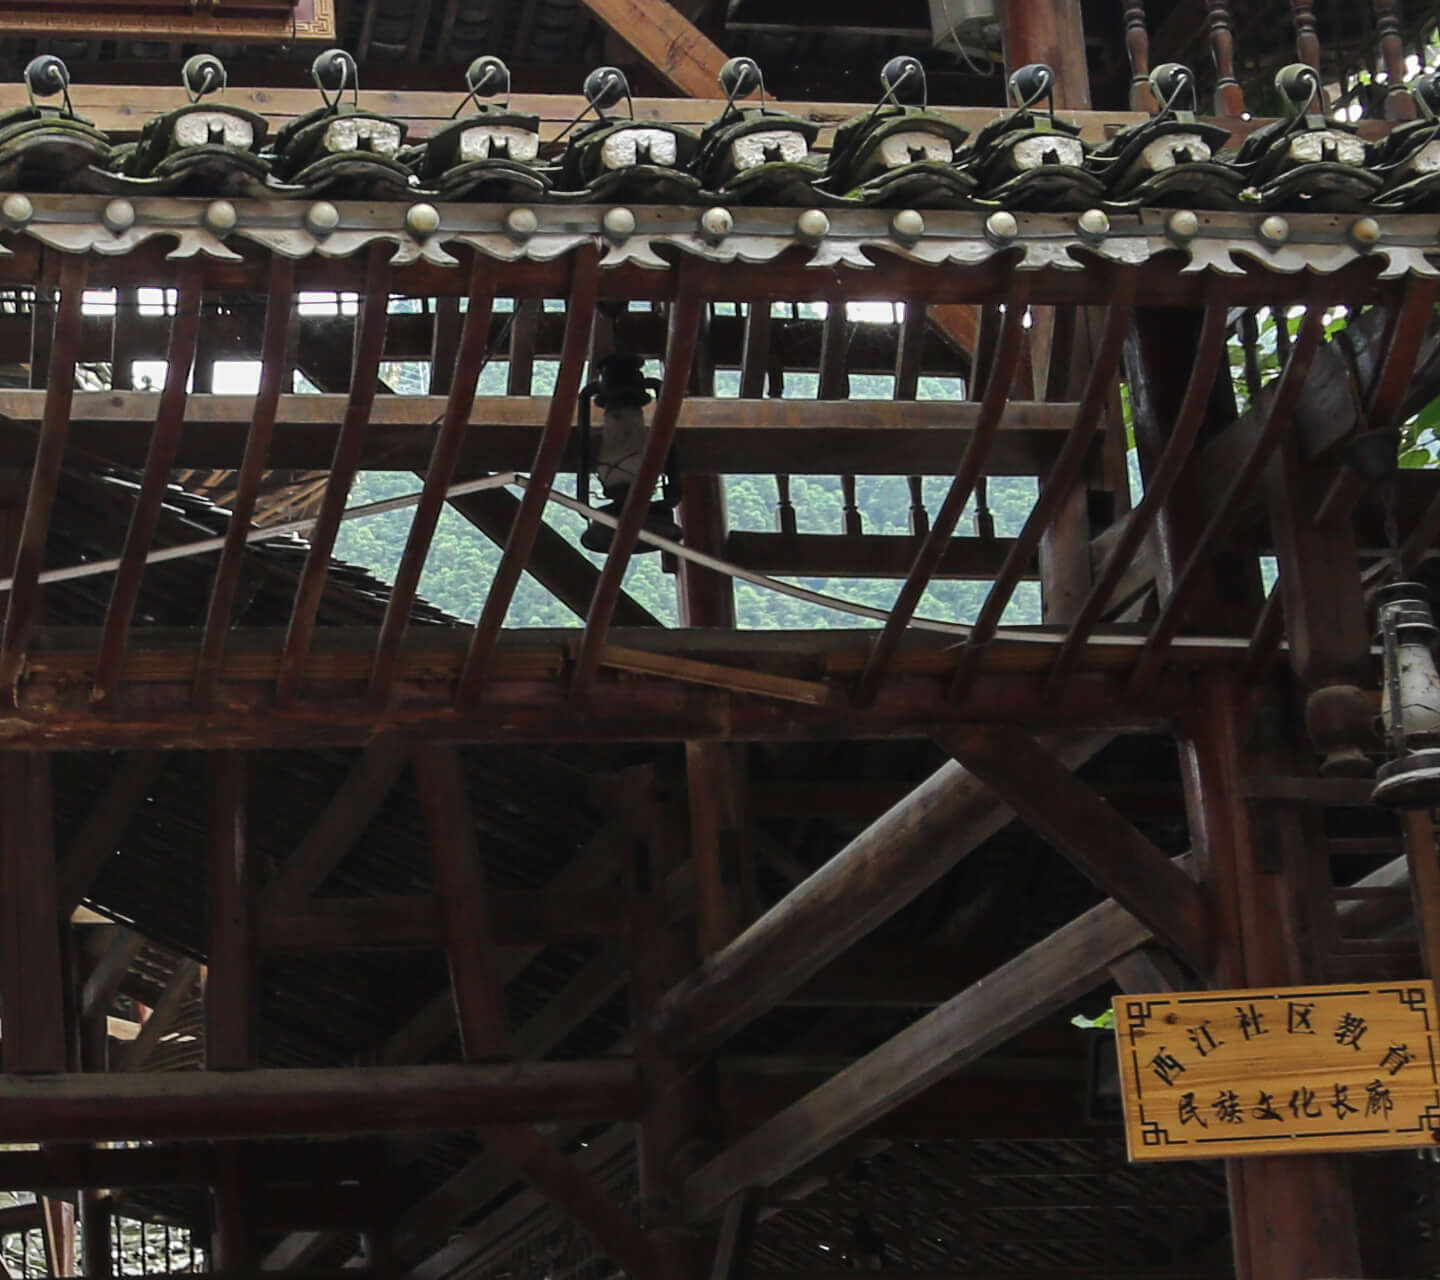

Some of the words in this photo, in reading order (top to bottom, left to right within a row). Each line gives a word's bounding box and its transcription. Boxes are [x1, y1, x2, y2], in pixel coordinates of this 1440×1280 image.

[1147, 1002, 1416, 1086] 西江社区教育
[1178, 1078, 1393, 1128] 民族文化长廊
